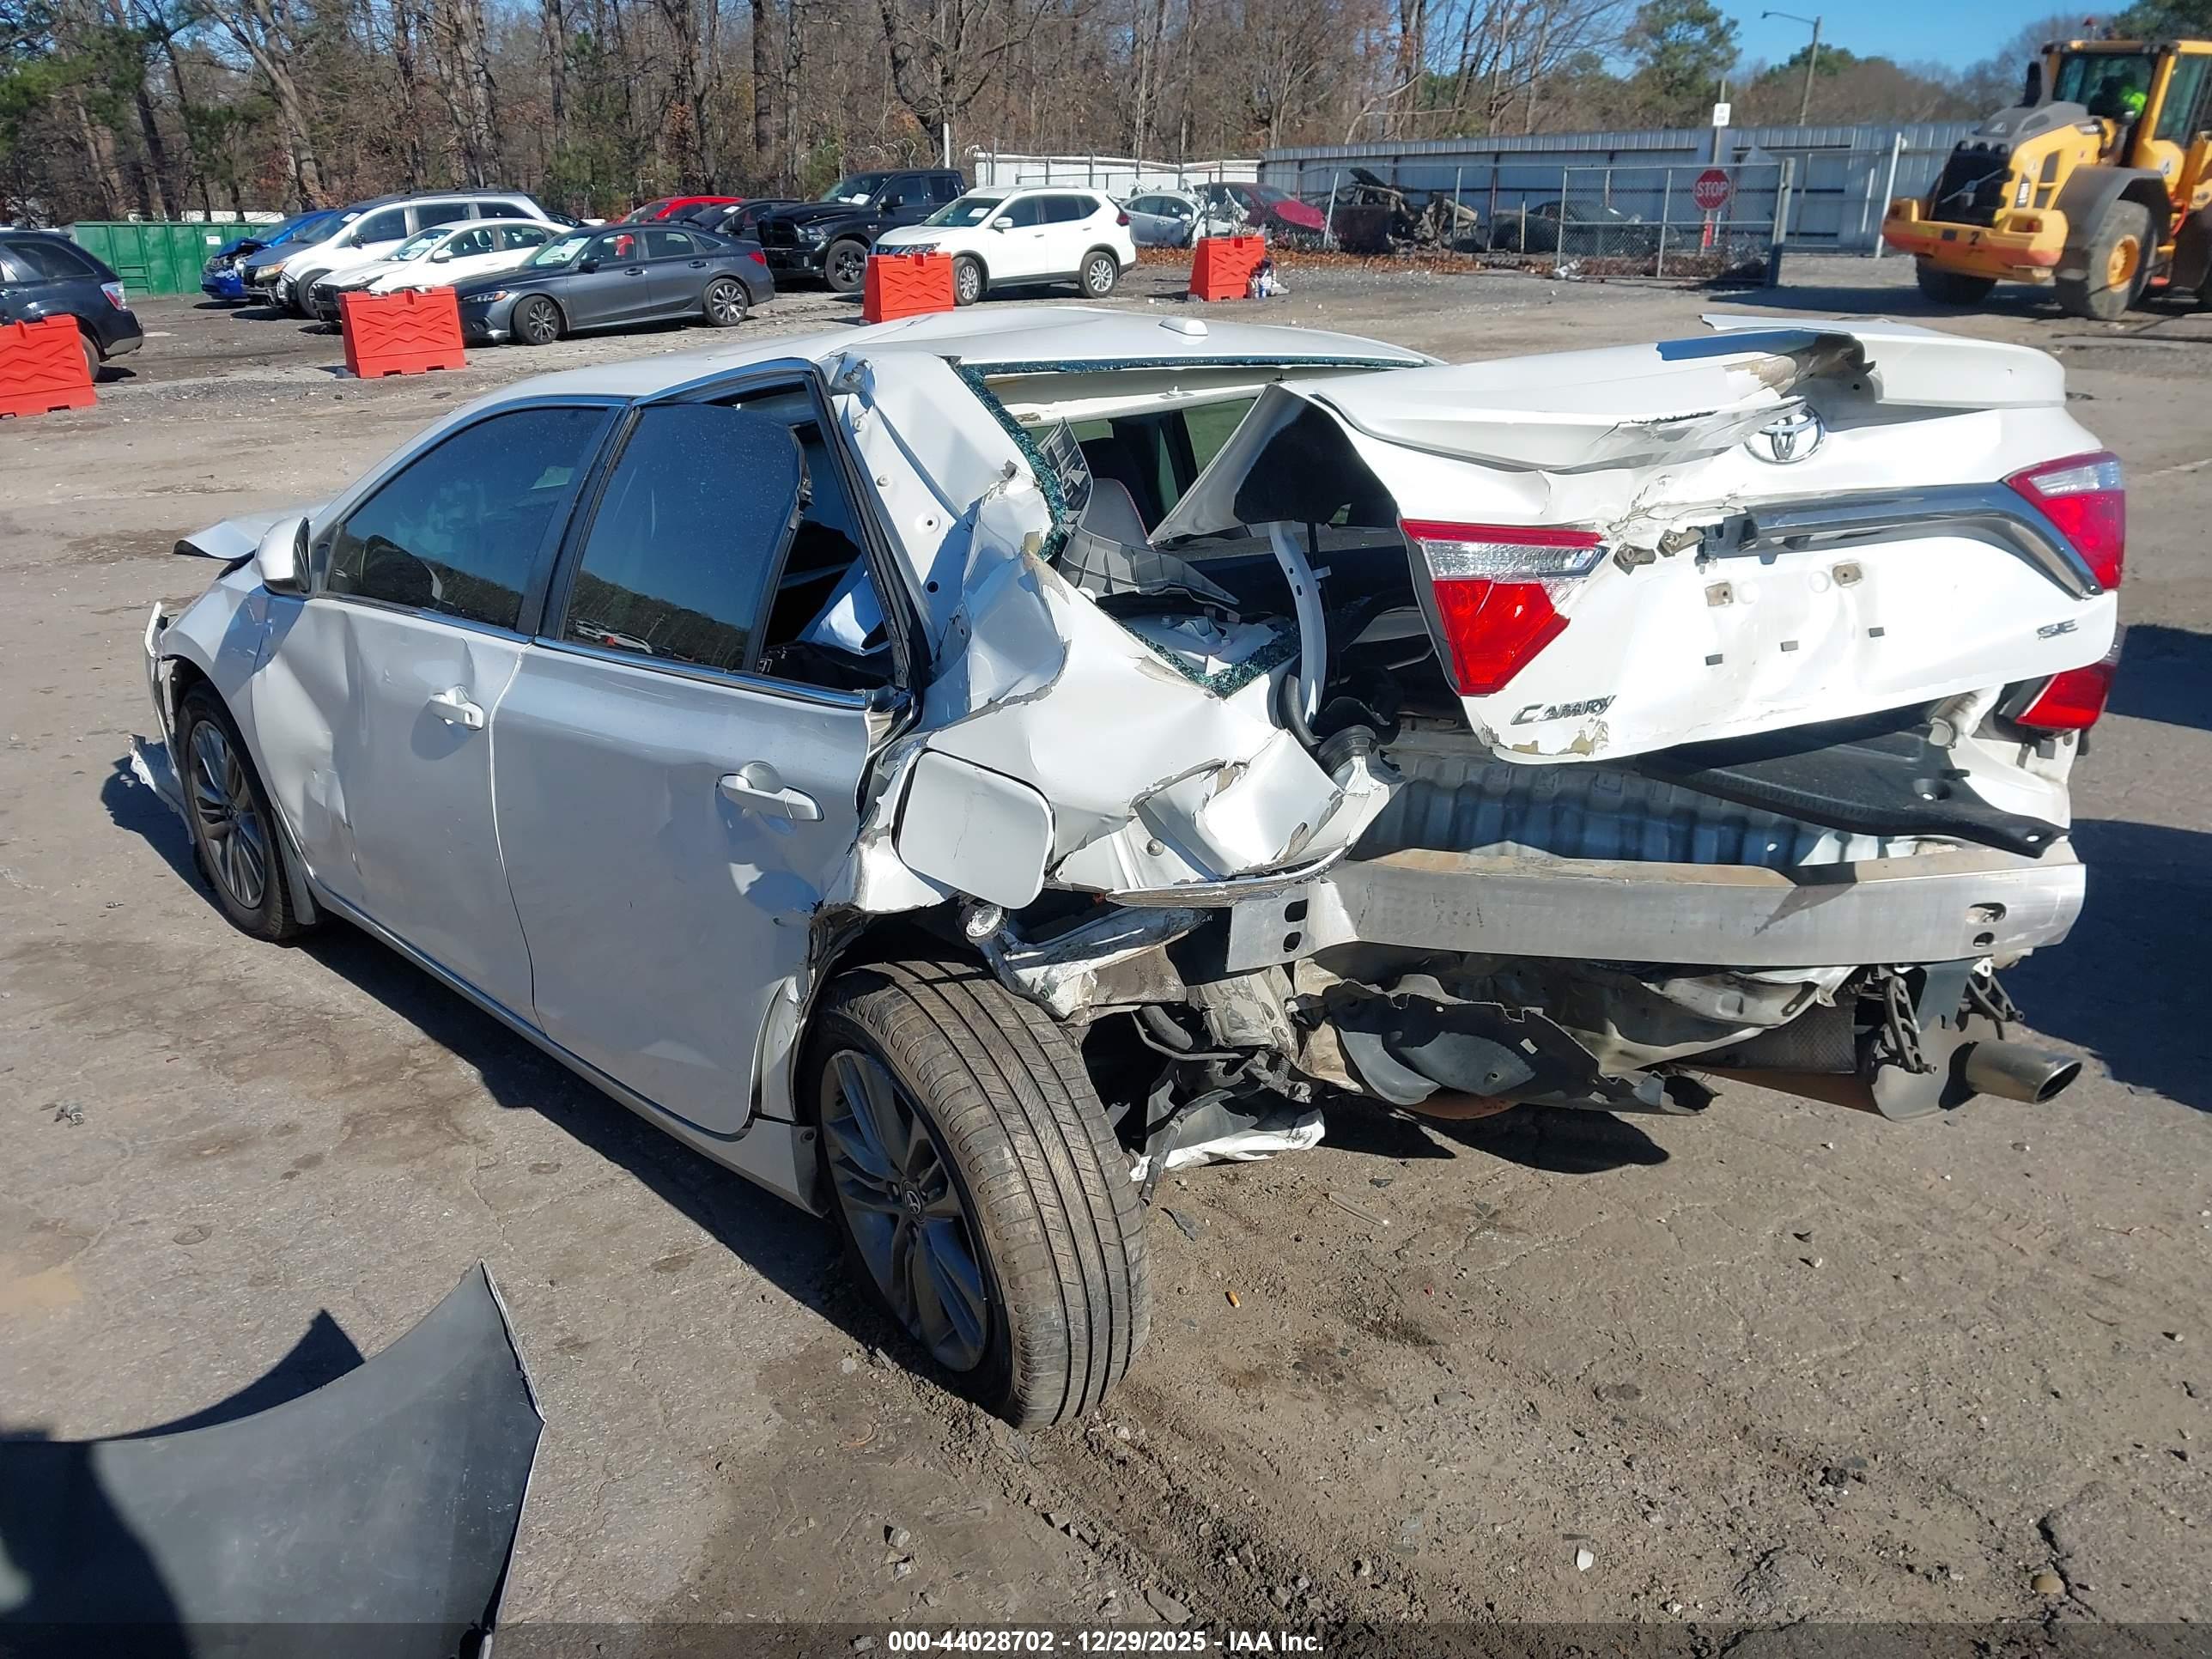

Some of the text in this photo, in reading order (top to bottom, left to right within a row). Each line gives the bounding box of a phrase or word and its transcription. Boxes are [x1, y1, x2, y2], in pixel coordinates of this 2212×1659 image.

[1696, 180, 1729, 198] STOP
[2037, 618, 2079, 641] SE
[1510, 695, 1617, 726] CAMRY
